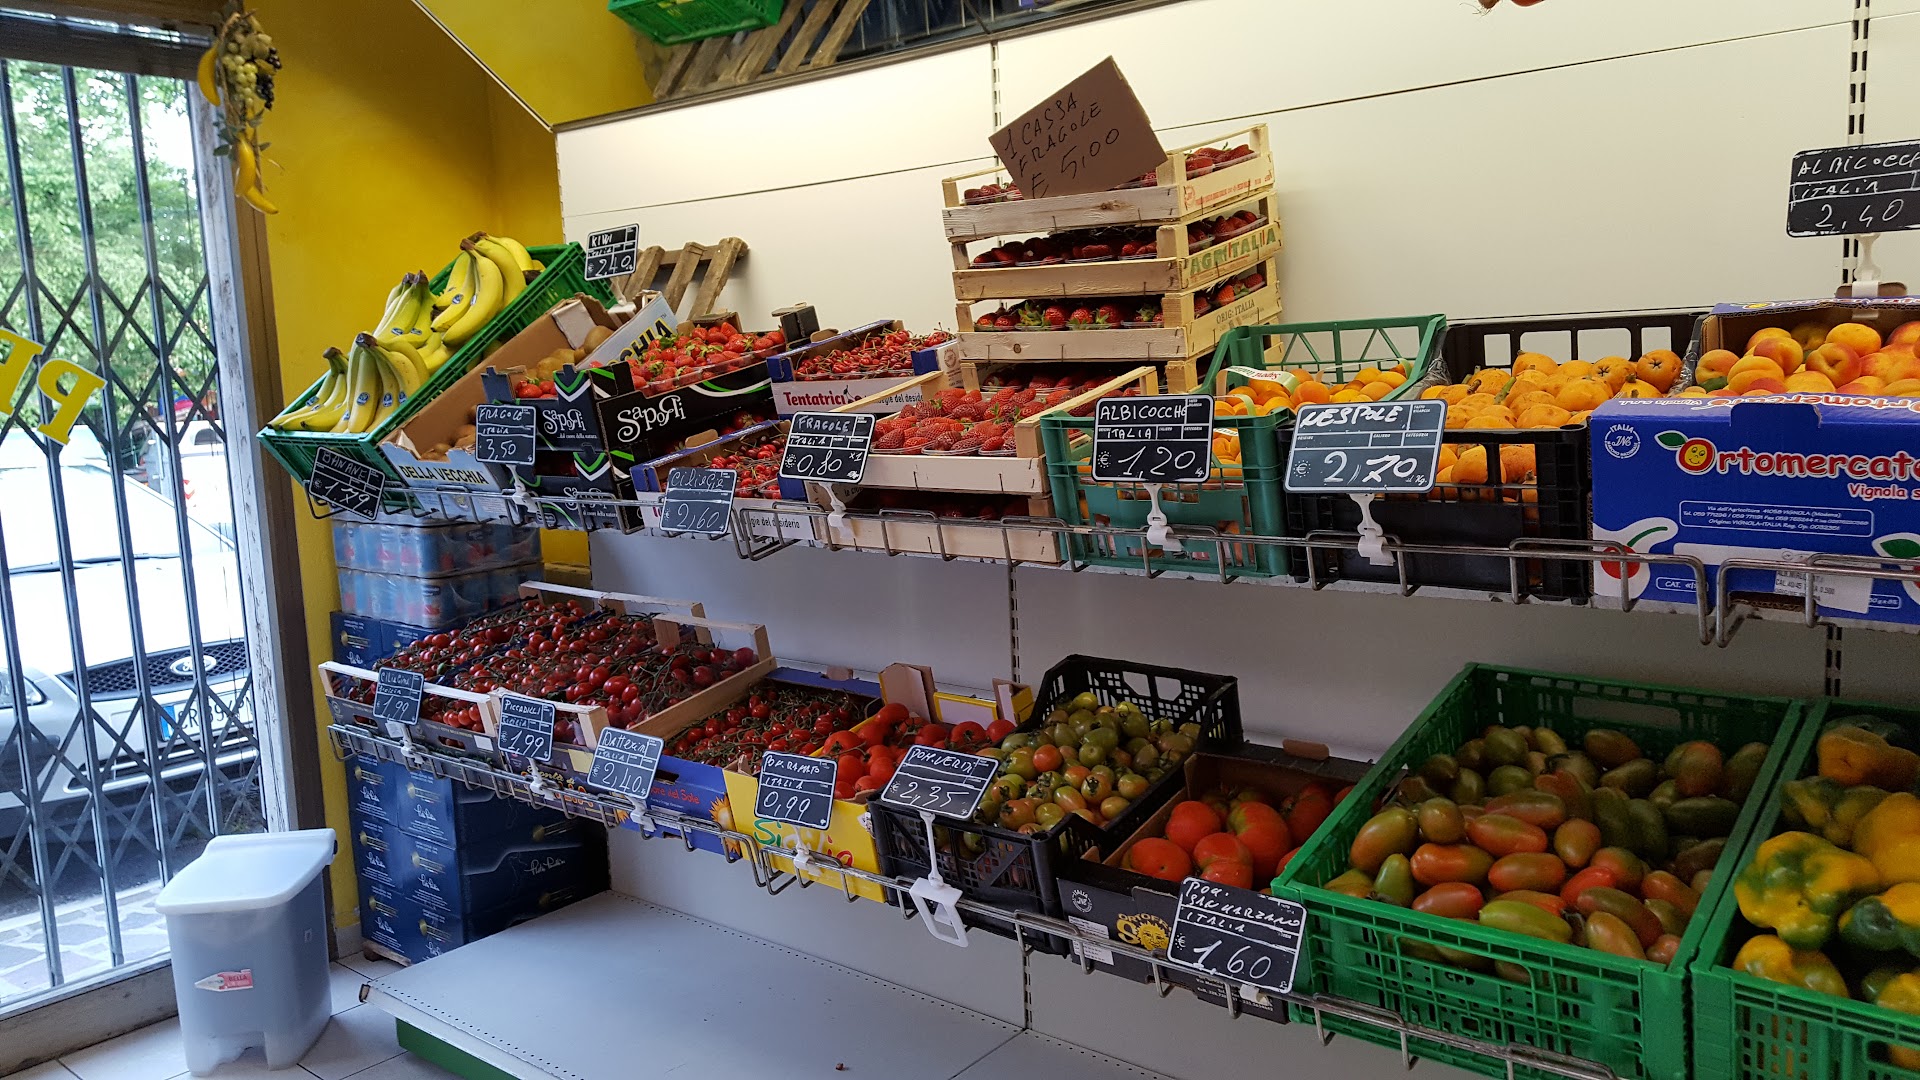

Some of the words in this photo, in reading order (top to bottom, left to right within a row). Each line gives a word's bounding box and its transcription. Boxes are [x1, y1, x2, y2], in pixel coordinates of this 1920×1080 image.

[1019, 102, 1101, 177] FRAGOLE
[1815, 198, 1904, 229] 2,40
[591, 233, 613, 247] KIWI
[596, 255, 632, 277] 2,40
[1234, 299, 1255, 316] ITALIA
[783, 390, 845, 406] Tentatrici
[797, 414, 851, 433] FRAGOLE
[1300, 404, 1403, 428] NESPOLE
[483, 427, 509, 435] ITALIA
[1107, 428, 1152, 439] ITALIA
[1609, 424, 1634, 433] ITALIA
[486, 439, 517, 460] 3,50
[321, 451, 368, 480] BANANE
[1118, 446, 1196, 479] 1,20
[399, 465, 436, 480] DELLA
[434, 467, 490, 485] VECCHIA
[1847, 482, 1908, 501] Vignola
[677, 503, 720, 530] 2,60
[508, 730, 545, 757] 1,99
[602, 762, 642, 793] 2,40
[766, 777, 804, 789] ITALIA
[764, 791, 811, 821] 0,99
[1186, 911, 1245, 933] ITALIA
